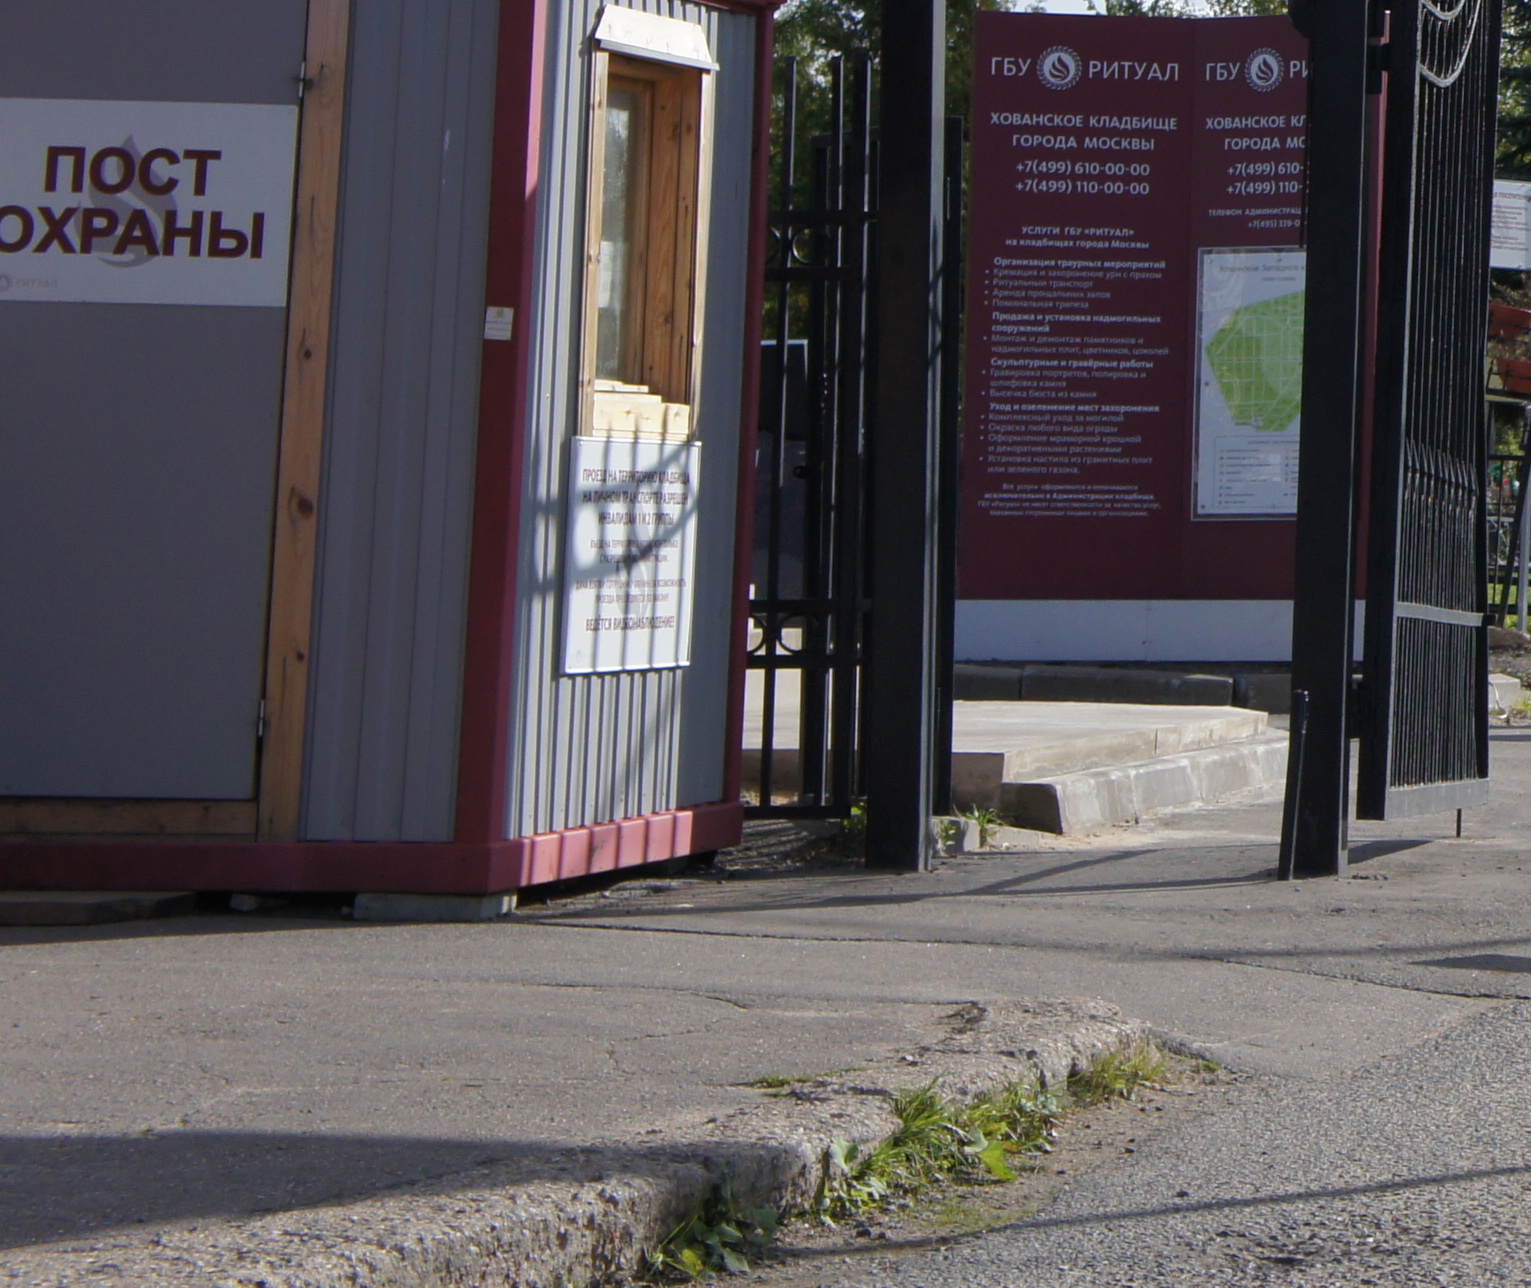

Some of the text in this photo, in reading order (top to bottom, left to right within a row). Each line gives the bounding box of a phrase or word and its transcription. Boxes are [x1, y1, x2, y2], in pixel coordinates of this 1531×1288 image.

[992, 57, 1178, 81] ГБУ РИТУАЛ
[1206, 62, 1240, 80] ГБУ
[991, 112, 1176, 131] ХОВАНСКОЕ КЛАДБИЩЕ
[1206, 116, 1286, 129] ХОВАНСКОЕ
[1013, 135, 1154, 150] ГОРОДА МОСКВЫ
[1225, 137, 1280, 150] ГОРОДА
[43, 146, 222, 196] ПОСТ
[1016, 160, 1150, 175] +7(499) 610-00-00
[1228, 161, 1275, 176] +7(499)
[1016, 178, 1149, 194] +7(499) 110-00-00
[1227, 180, 1275, 196] +7(499)
[0, 205, 265, 259] ОХРАНЫ
[1022, 226, 1134, 236] УСЛУГИ ГБУ «РИТУАЛ»
[1020, 238, 1074, 248] кладбищах
[1076, 241, 1109, 249] города
[1111, 240, 1149, 248] Москвы
